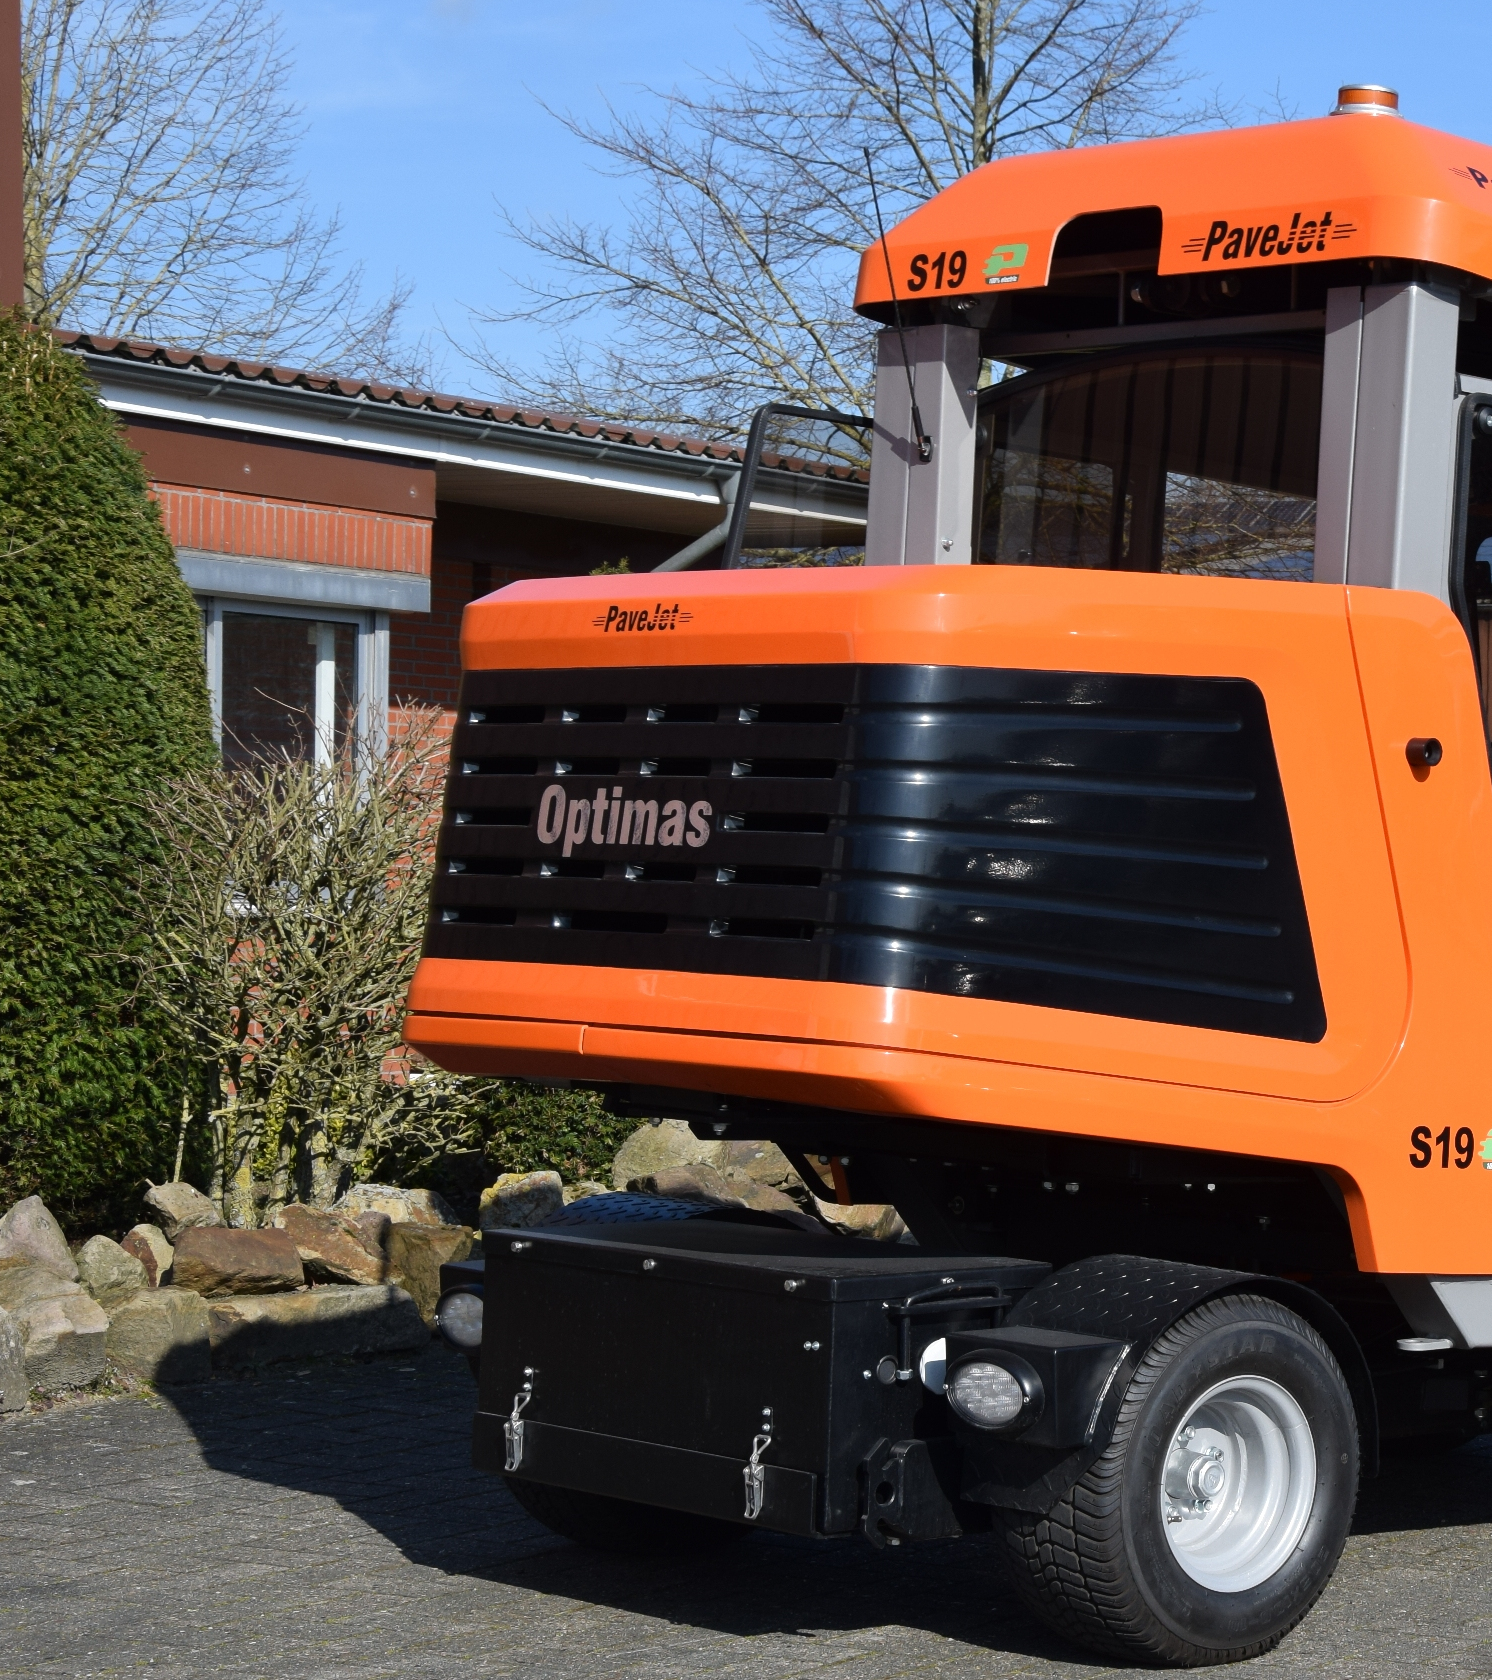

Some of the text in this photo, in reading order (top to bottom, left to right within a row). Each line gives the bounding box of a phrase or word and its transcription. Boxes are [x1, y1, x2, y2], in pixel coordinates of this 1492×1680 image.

[1201, 211, 1333, 262] PaveJet
[907, 249, 967, 292] S19
[604, 603, 679, 633] PaveJet
[537, 784, 713, 858] Optimas
[1409, 1125, 1475, 1170] S19
